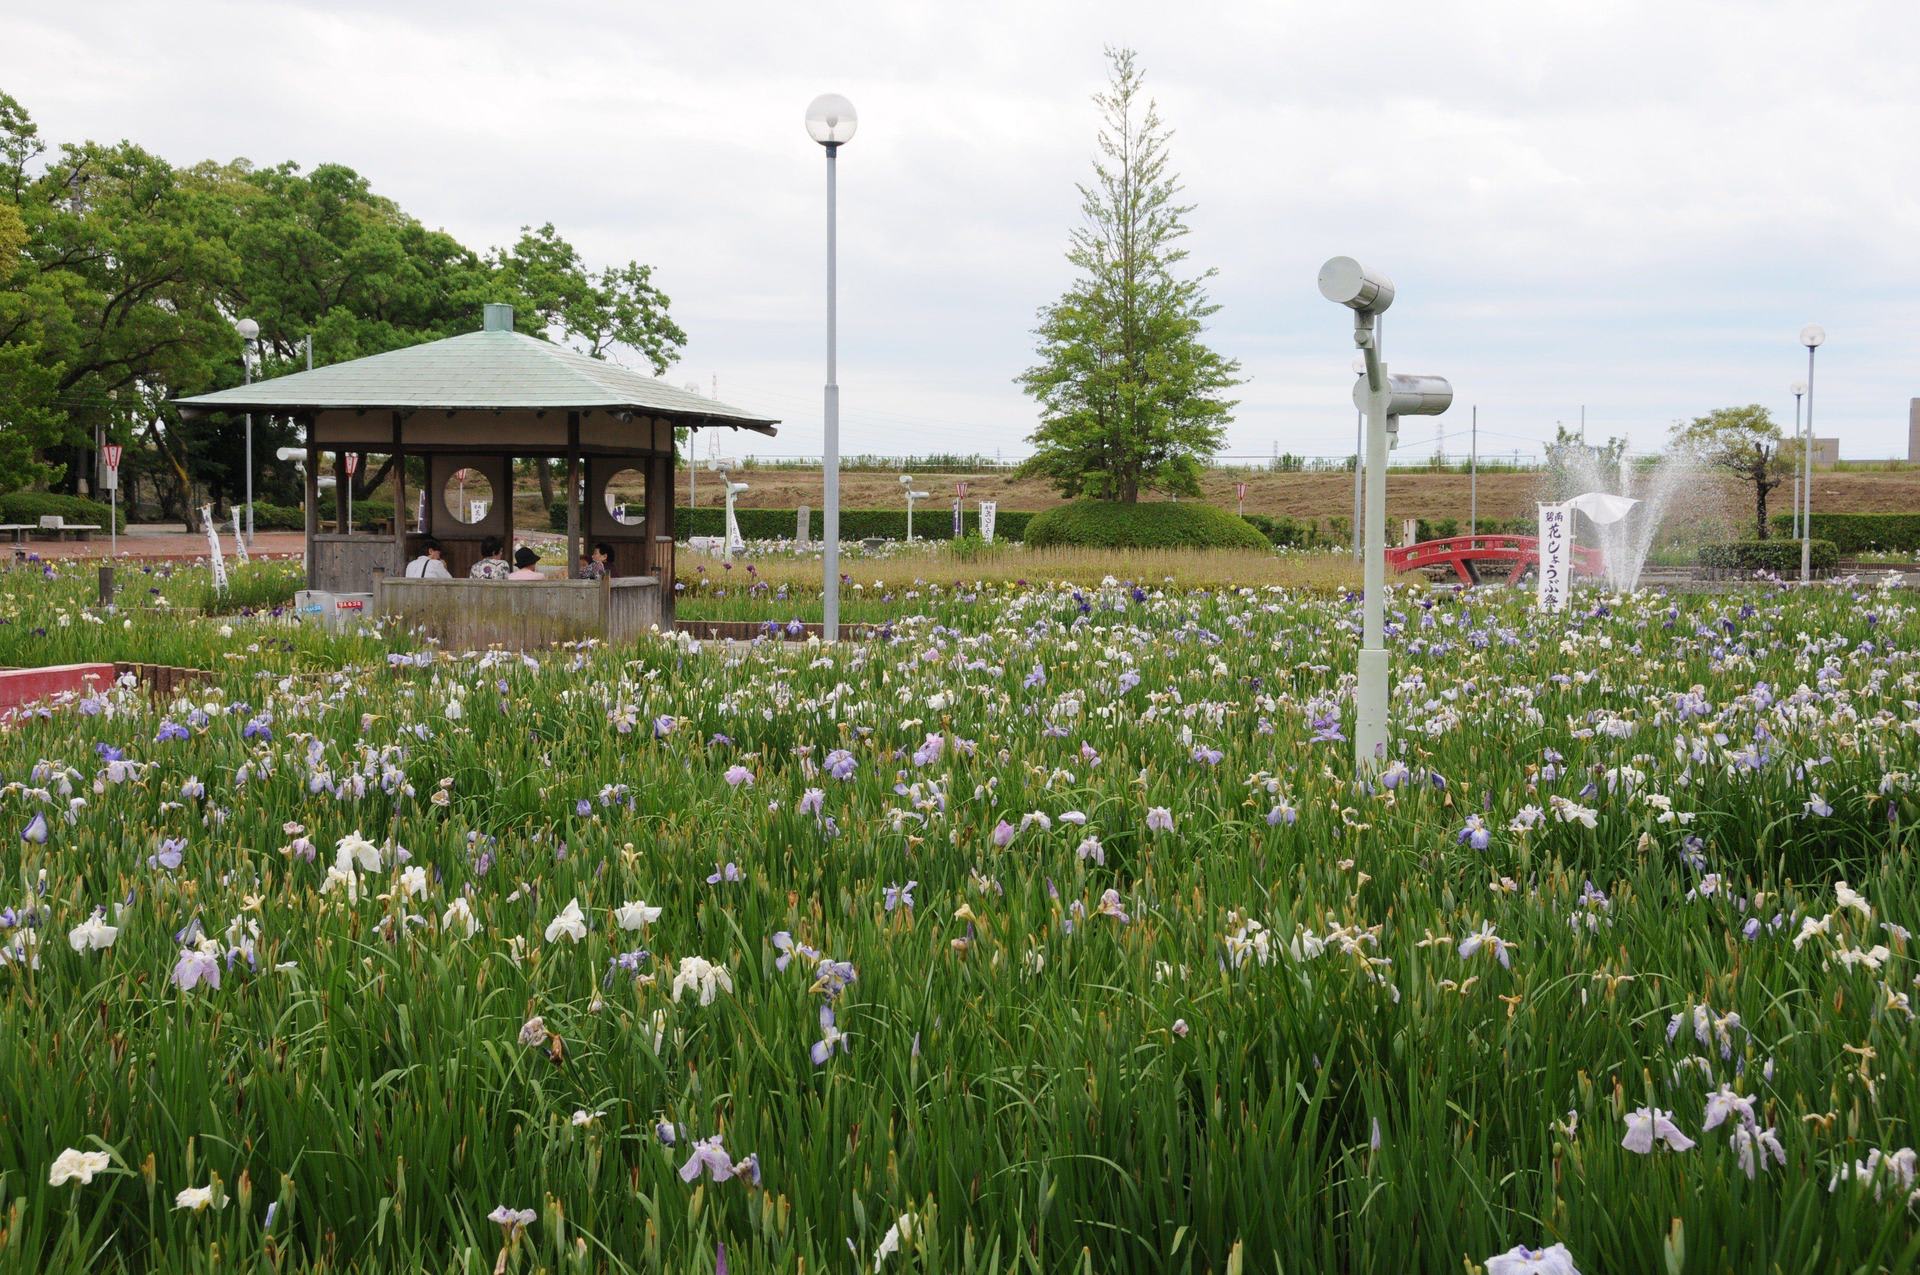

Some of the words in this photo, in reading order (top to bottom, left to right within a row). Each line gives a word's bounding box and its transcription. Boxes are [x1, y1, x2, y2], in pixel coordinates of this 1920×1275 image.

[1544, 524, 1561, 607] 花しょうぶ祭
